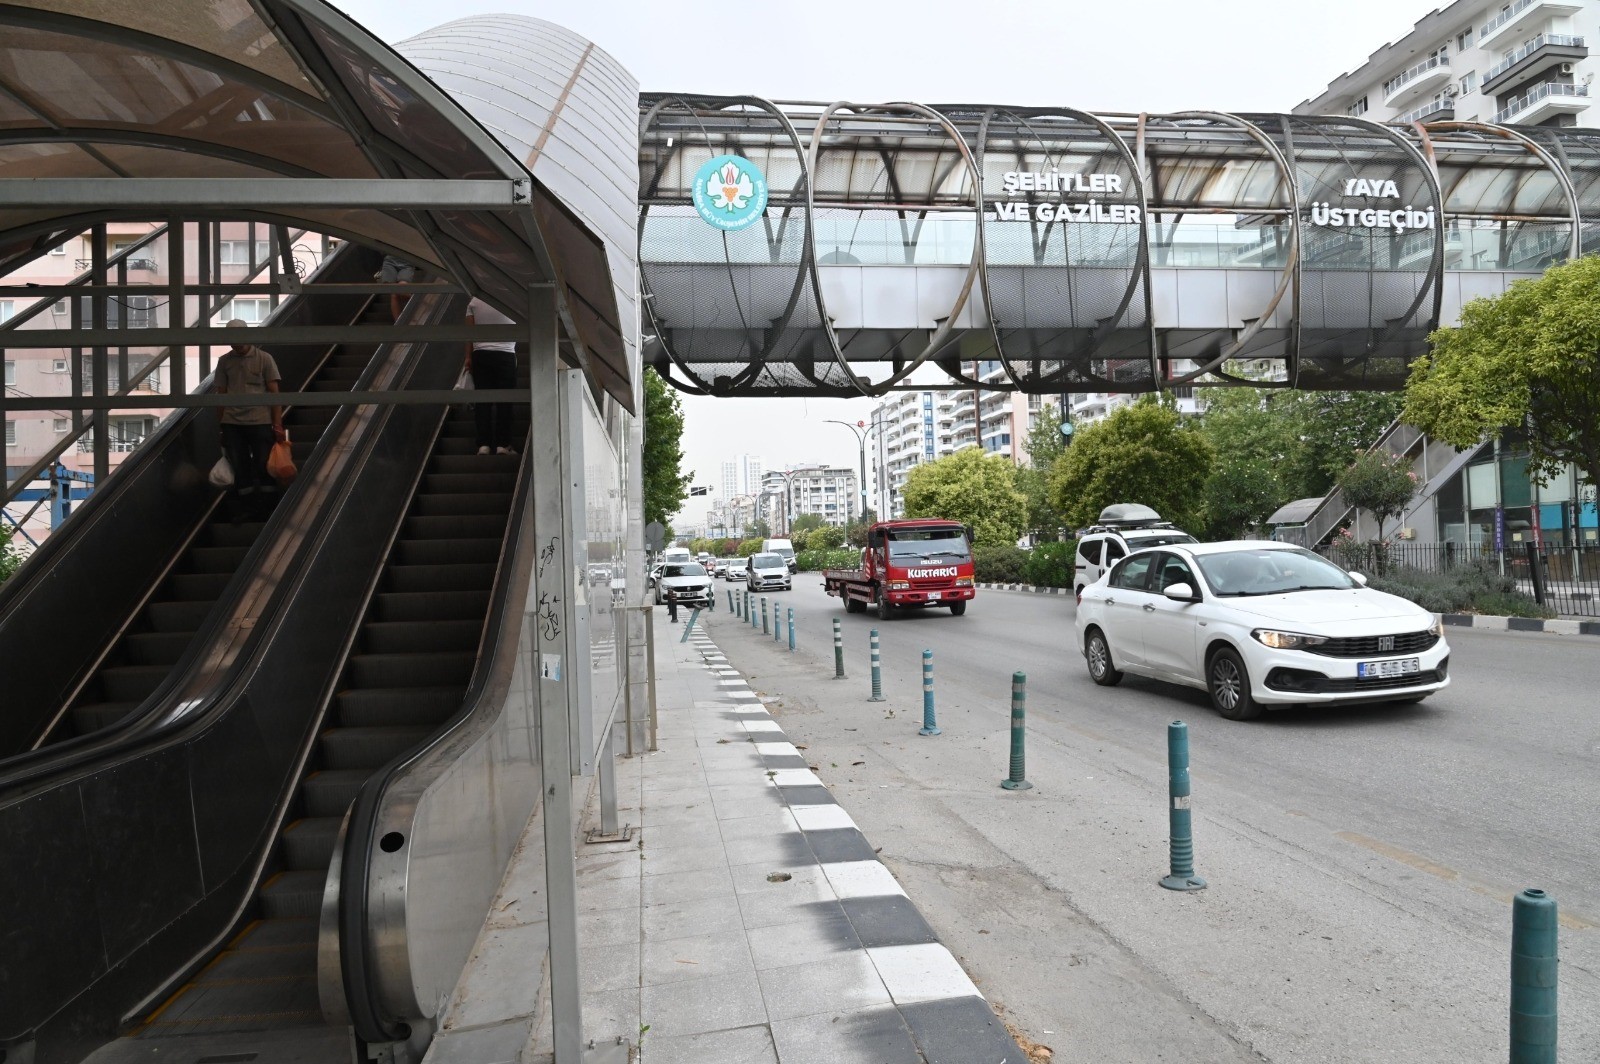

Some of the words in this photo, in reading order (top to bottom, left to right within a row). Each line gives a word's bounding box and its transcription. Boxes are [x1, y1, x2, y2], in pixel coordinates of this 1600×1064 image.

[1003, 167, 1122, 196] ŞEHİTLER
[1345, 179, 1400, 198] YAYA
[995, 202, 1030, 221] VE
[1035, 199, 1141, 223] GAZİLER
[907, 567, 957, 578] KURTARICI
